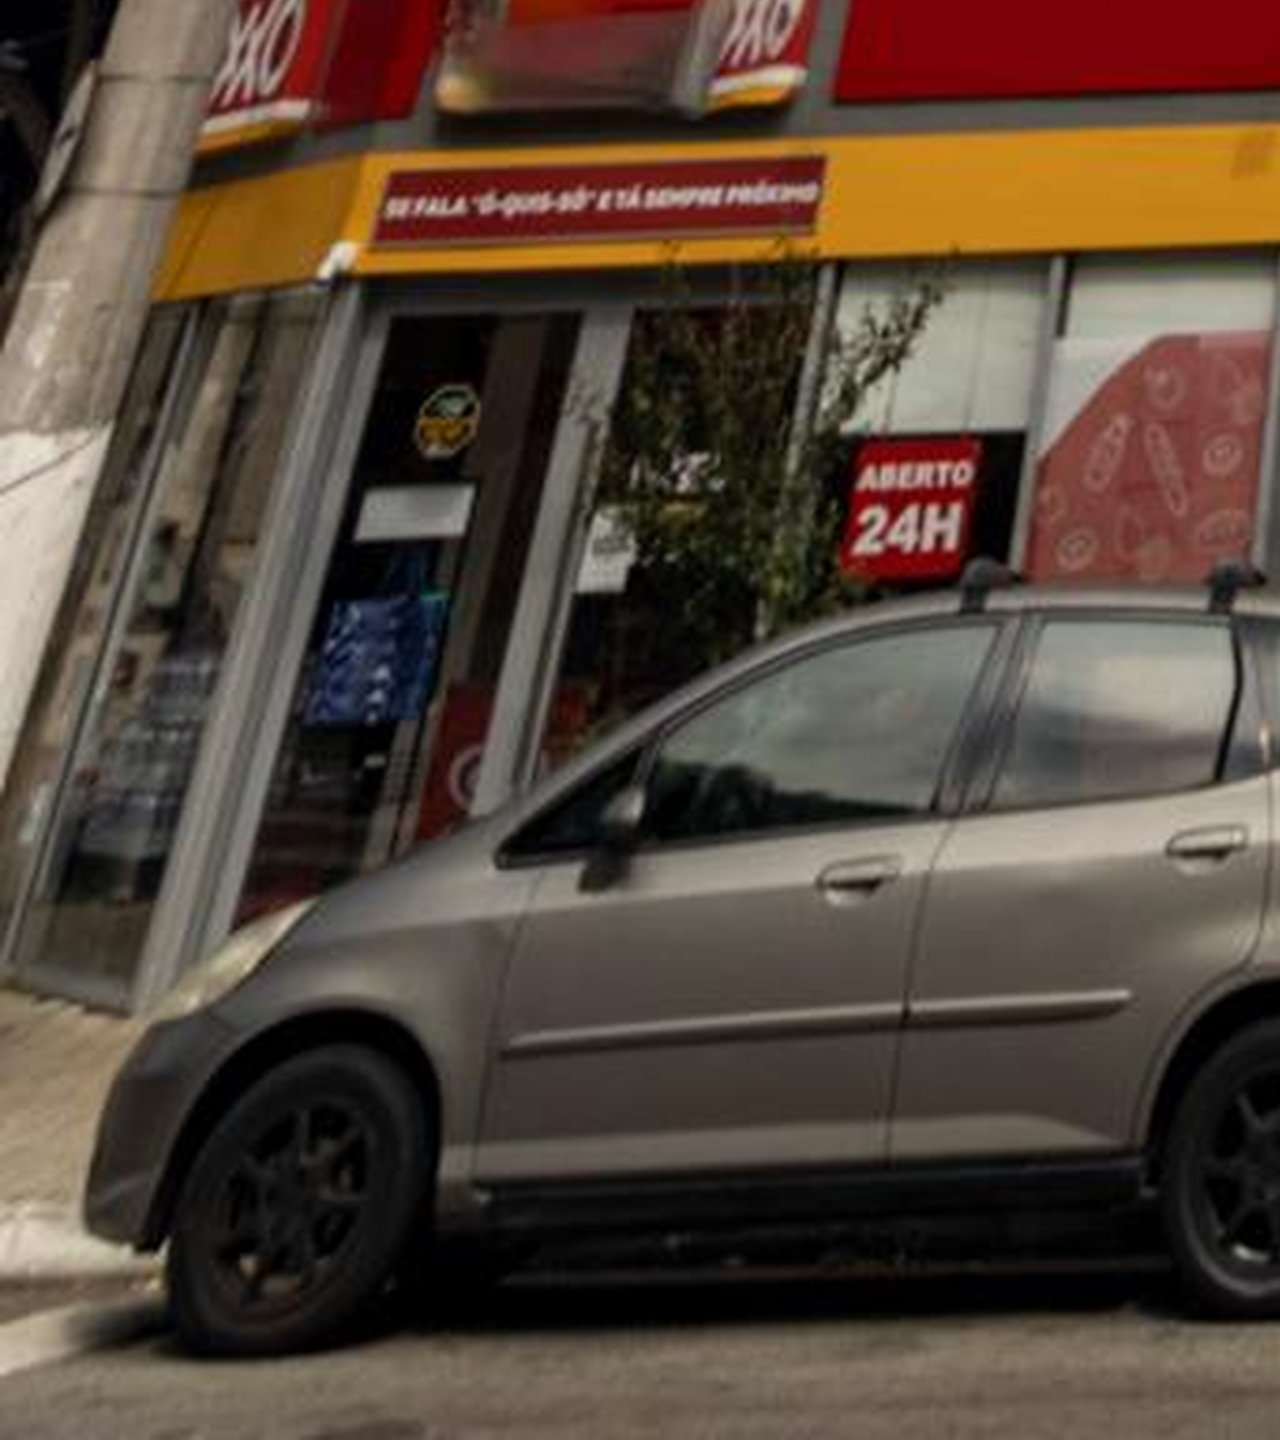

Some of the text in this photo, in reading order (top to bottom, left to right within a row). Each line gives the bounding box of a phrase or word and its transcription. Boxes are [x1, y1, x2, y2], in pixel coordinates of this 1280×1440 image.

[384, 196, 410, 220] SE
[411, 194, 469, 218] FALA
[643, 183, 724, 211] SEMPRE
[856, 460, 975, 491] ABERTO
[850, 500, 963, 557] 24H
